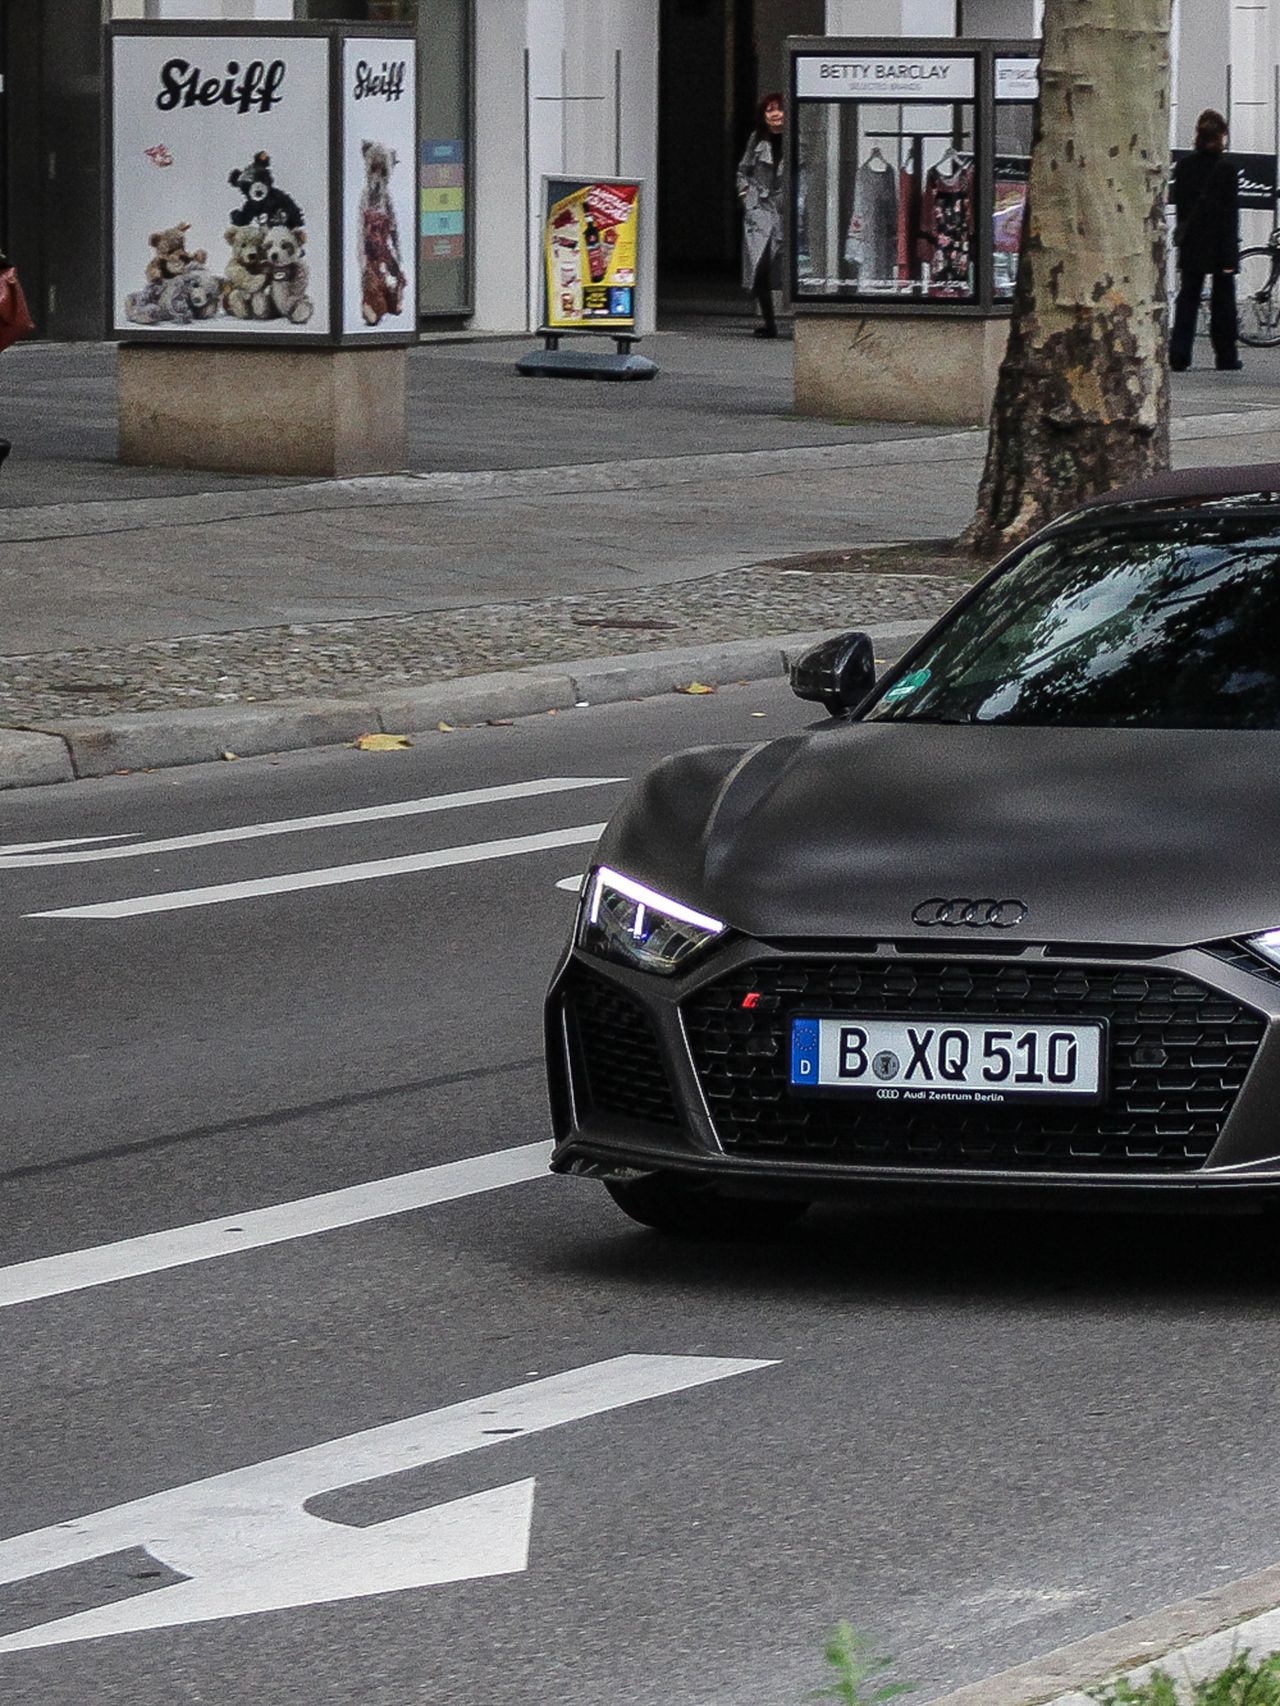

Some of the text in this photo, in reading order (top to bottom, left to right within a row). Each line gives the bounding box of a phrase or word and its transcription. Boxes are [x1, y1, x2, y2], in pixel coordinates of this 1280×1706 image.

[156, 58, 286, 114] Steiff
[354, 60, 406, 101] Steiff
[820, 64, 951, 80] BETTY BARCLAY
[799, 1026, 1078, 1084] D B XQ 510
[903, 1090, 1004, 1101] Audi Zentrum Berlin
